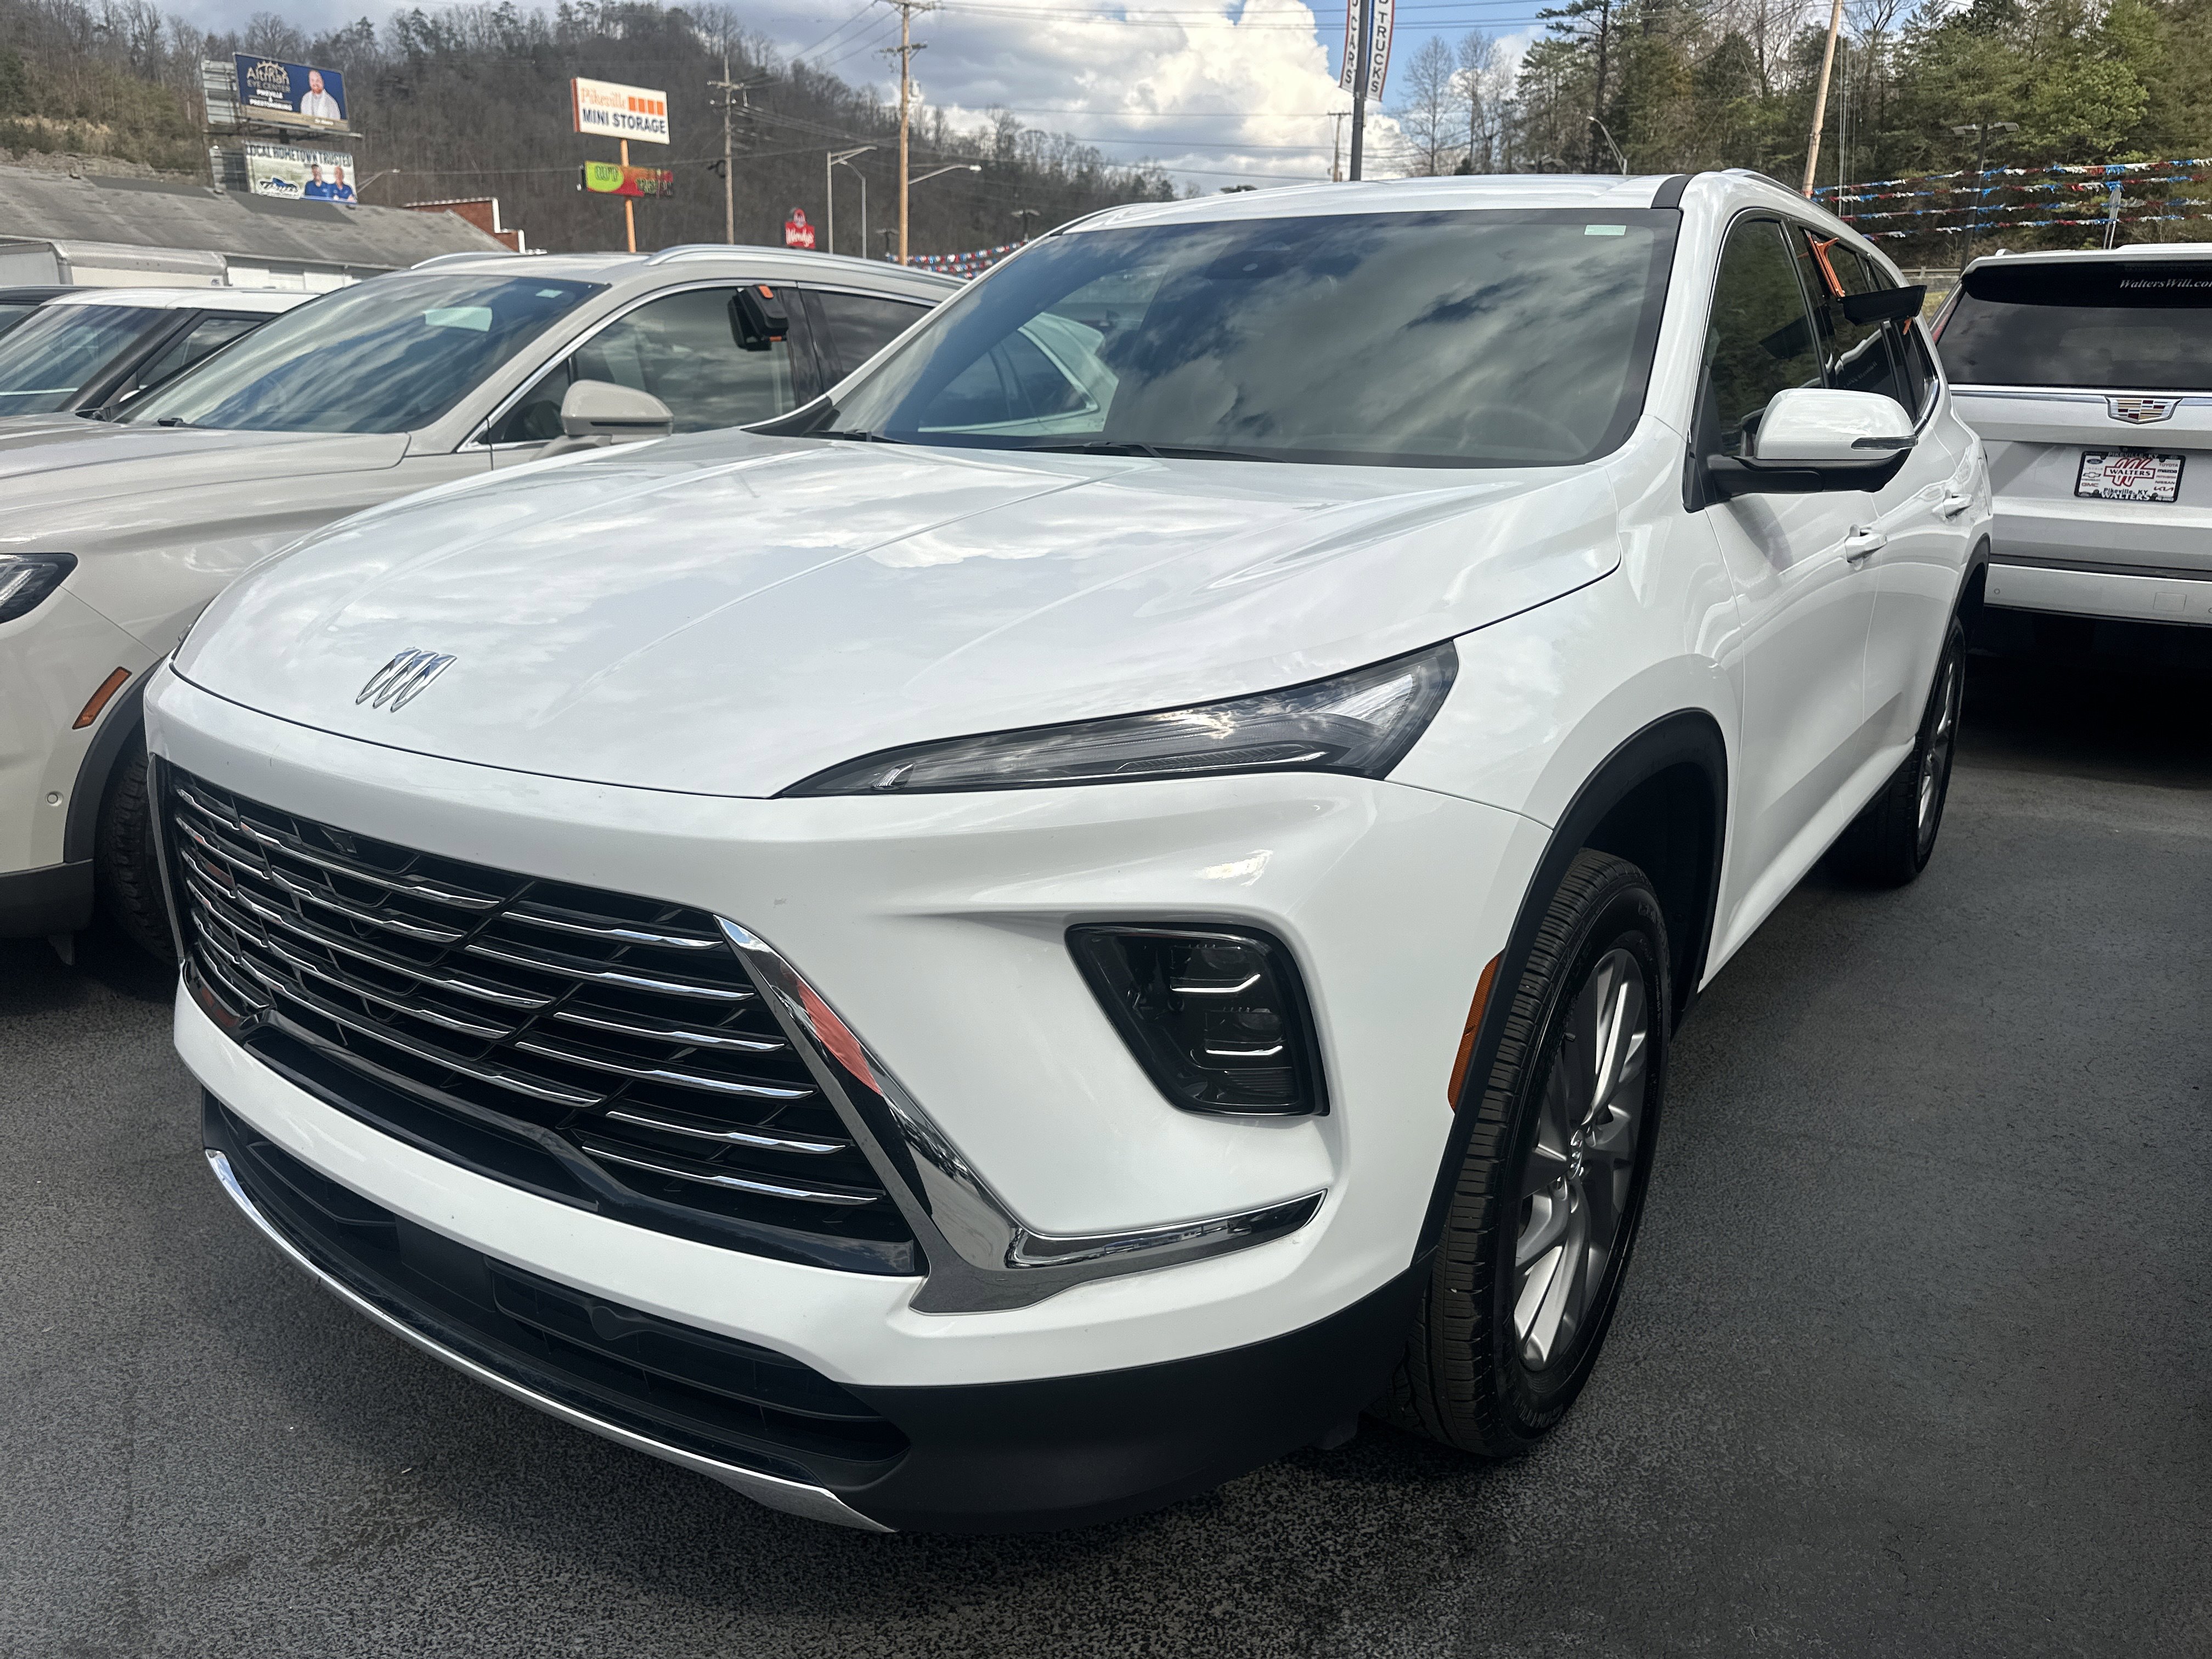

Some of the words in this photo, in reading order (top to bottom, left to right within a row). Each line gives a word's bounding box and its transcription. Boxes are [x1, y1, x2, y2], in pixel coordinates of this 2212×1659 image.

[1345, 16, 1358, 84] CARS
[1371, 11, 1387, 93] TRUCKS
[583, 108, 609, 126] MINI
[612, 112, 666, 134] STORAGE
[247, 145, 272, 157] LOCAL
[274, 147, 318, 163] HOMETOWN
[2101, 492, 2150, 500] WALTERS
